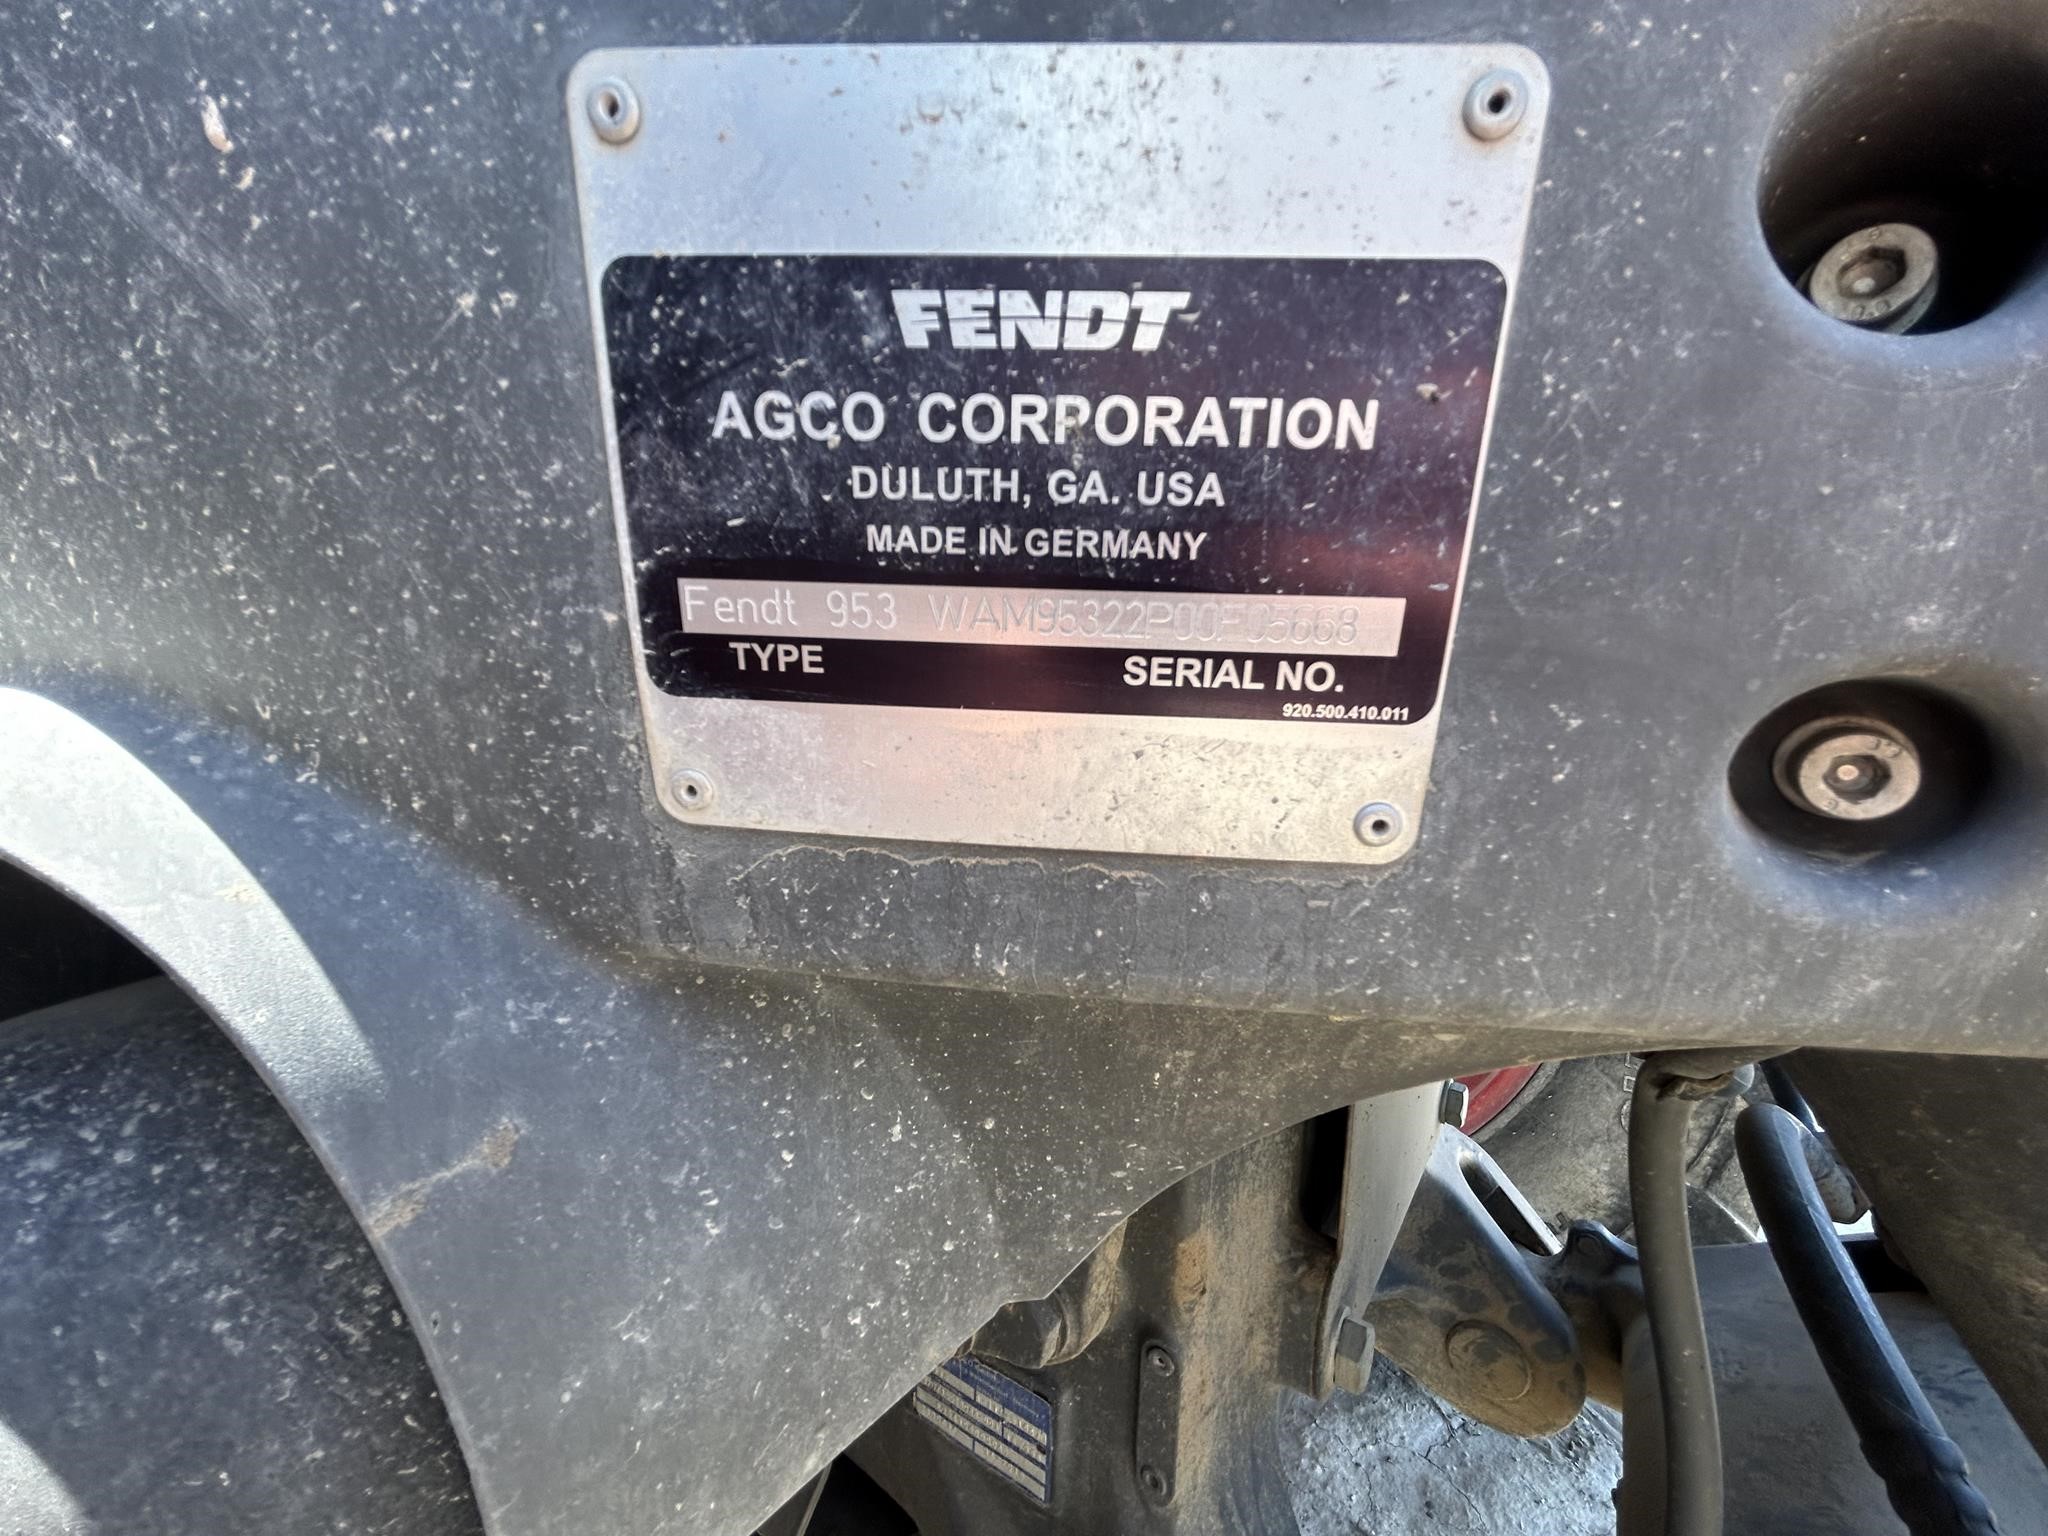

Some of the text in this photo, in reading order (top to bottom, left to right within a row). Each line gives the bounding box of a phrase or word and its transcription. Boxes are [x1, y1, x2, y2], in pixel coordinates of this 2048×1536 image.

[892, 289, 1191, 351] FENDT
[712, 390, 1380, 450] AGCO CORPORATION
[851, 465, 1225, 508] DULUTH, GA. USA
[866, 523, 1206, 561] MADE IN GERMANY
[682, 585, 798, 628] Fendt
[825, 589, 898, 630] 953
[728, 642, 1345, 693] TYPE SERIAL NO.
[1281, 702, 1410, 722] 920.500.410.011
